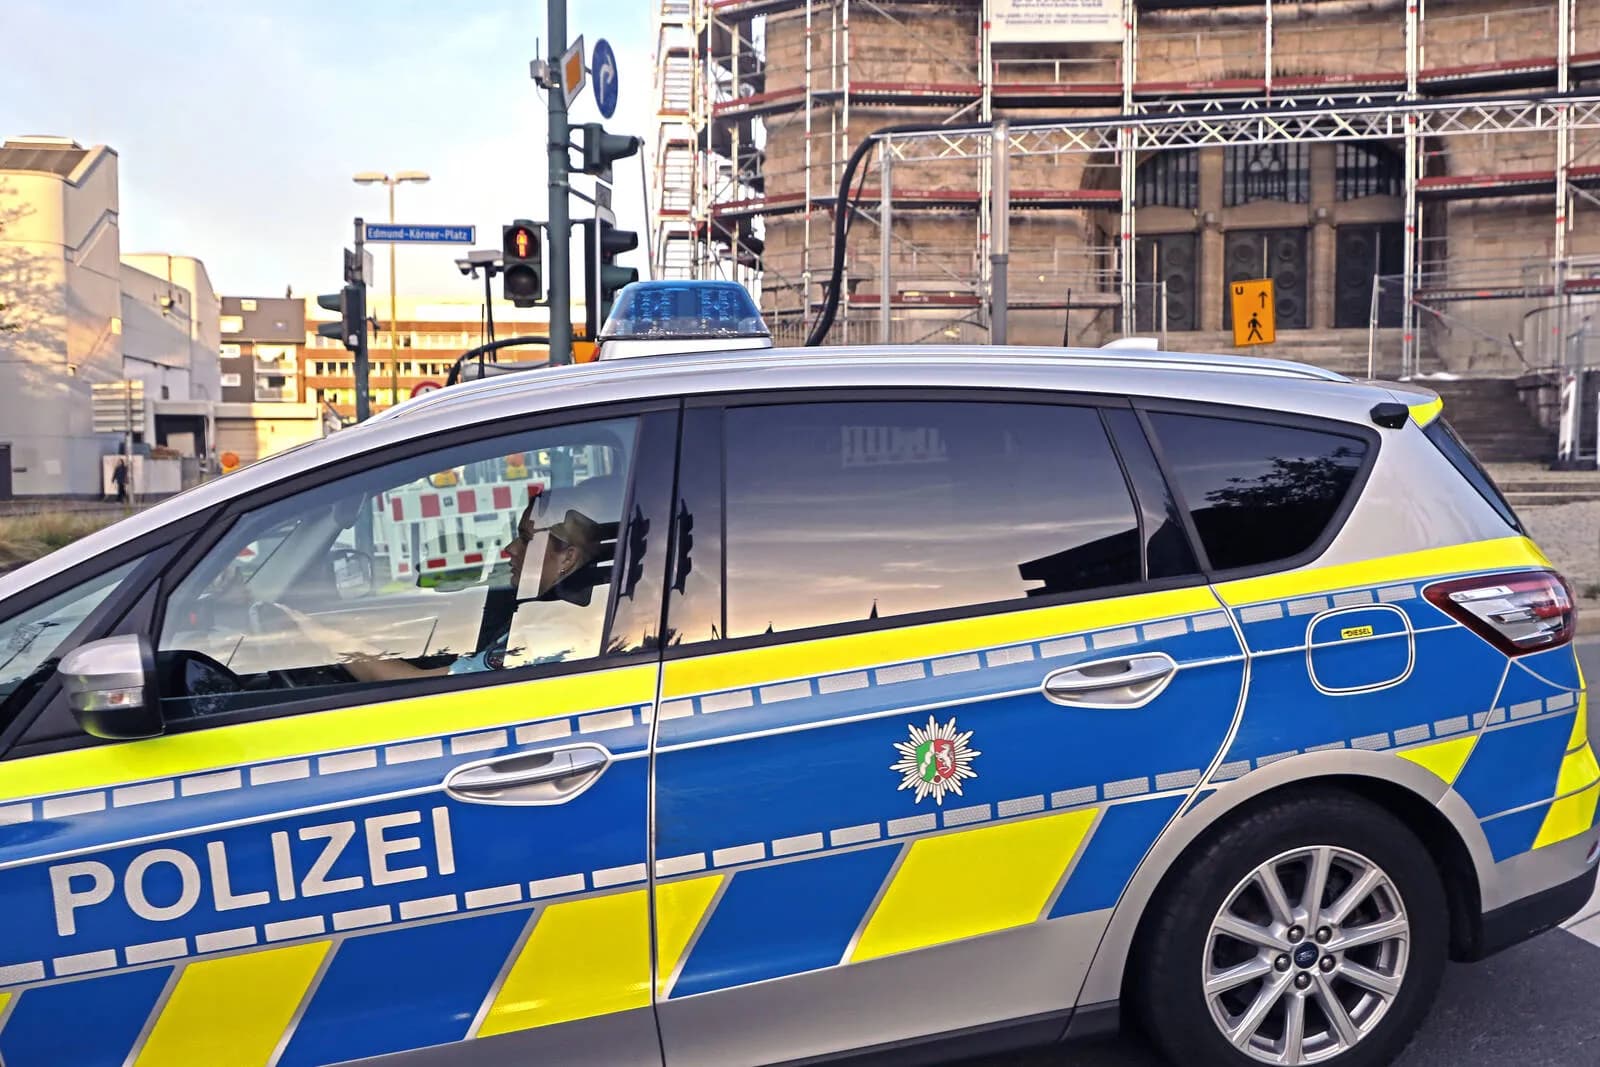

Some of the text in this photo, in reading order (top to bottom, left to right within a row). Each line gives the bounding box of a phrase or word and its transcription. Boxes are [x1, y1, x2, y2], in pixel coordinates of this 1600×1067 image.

[367, 227, 467, 241] Edmund-Körner-Platz
[1235, 286, 1244, 295] U
[1346, 628, 1371, 637] DIESEL
[48, 806, 456, 937] POLIZEI
